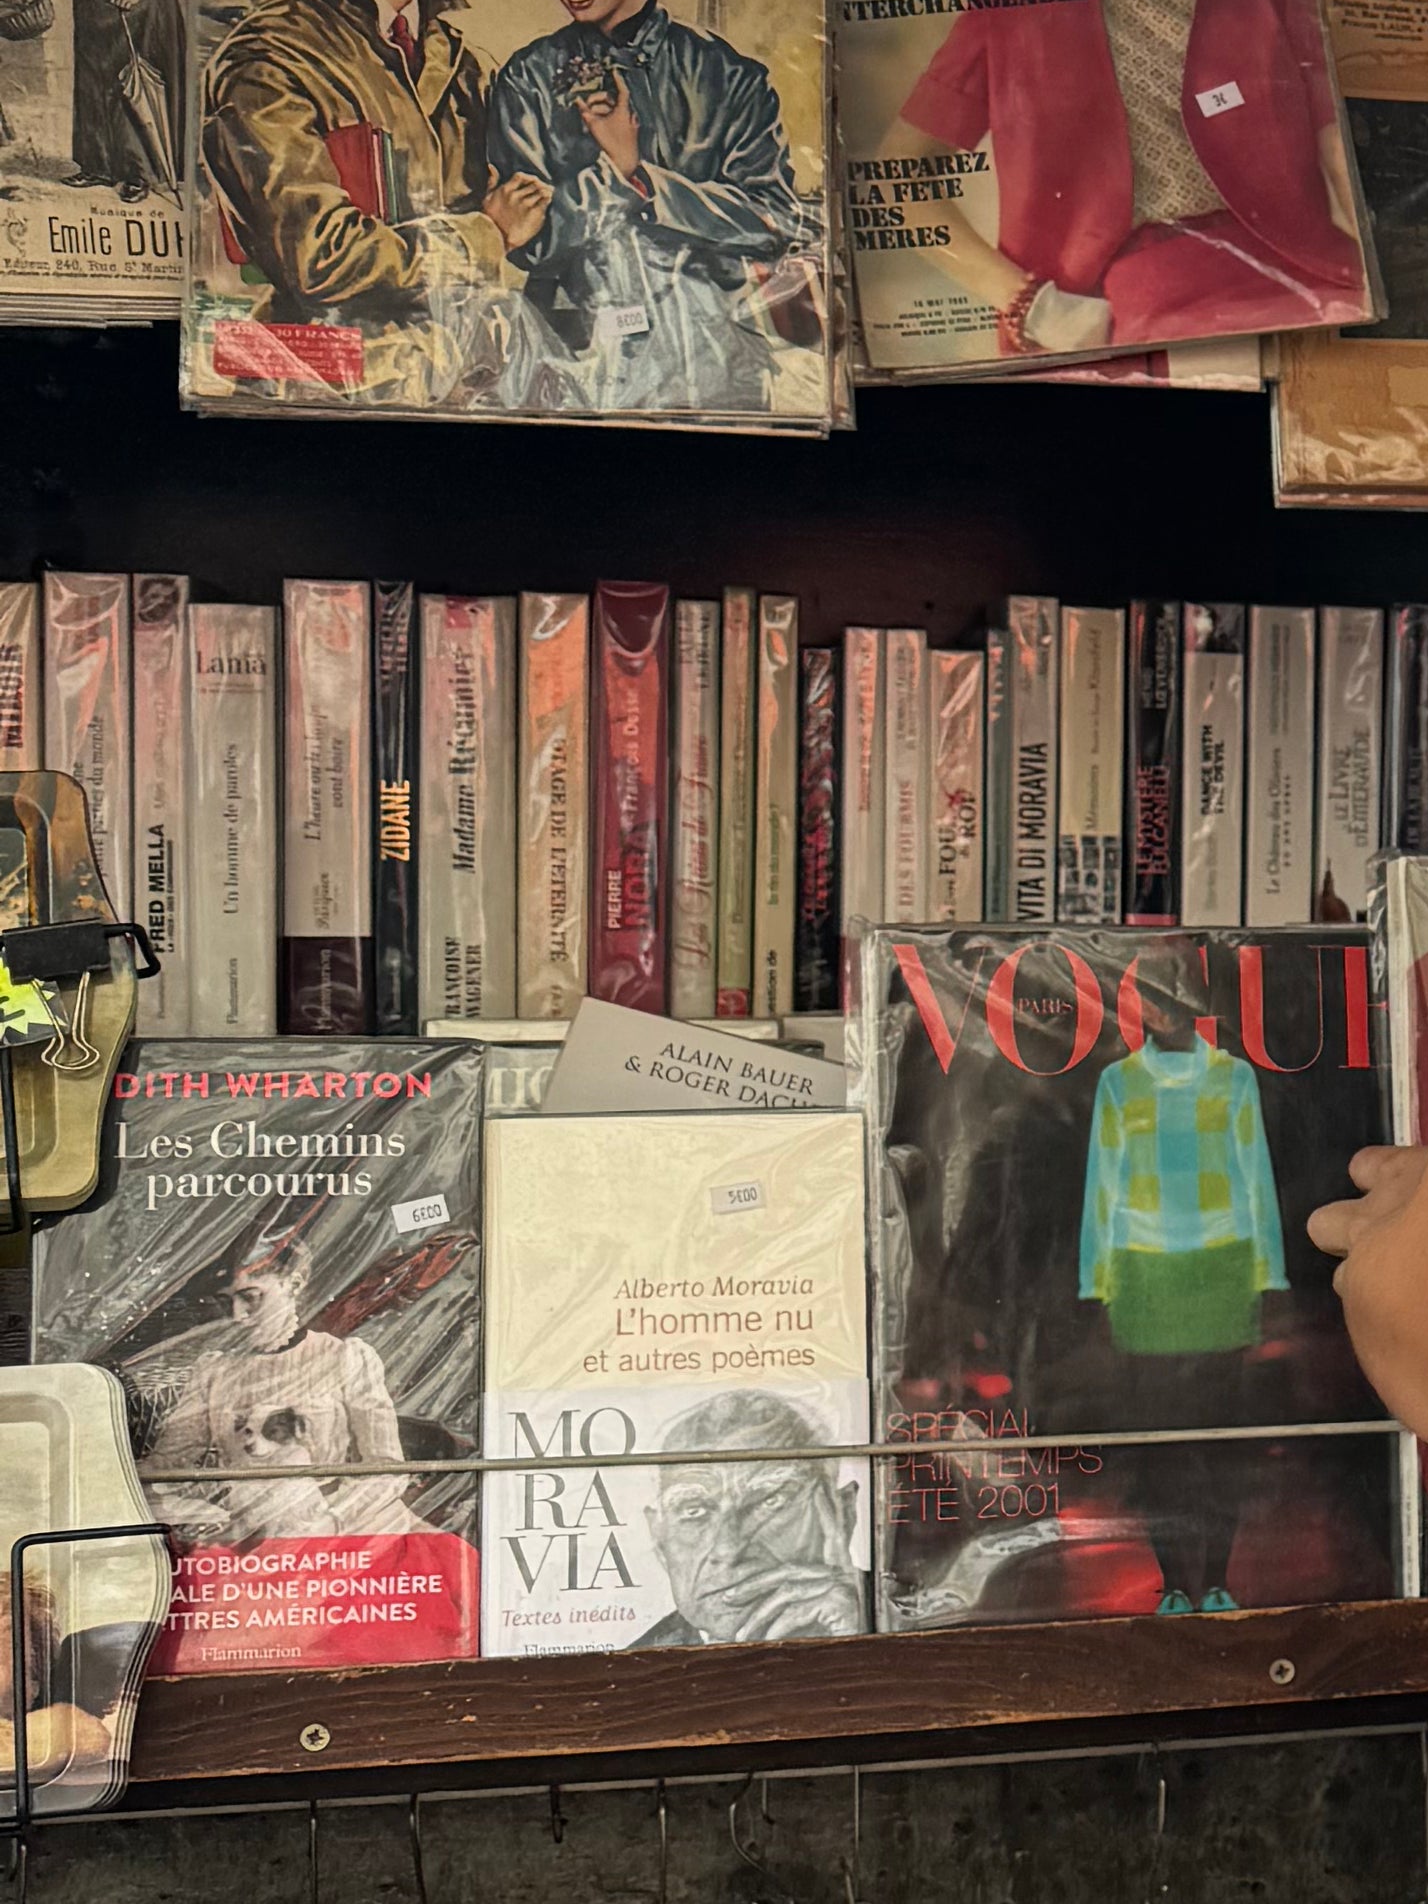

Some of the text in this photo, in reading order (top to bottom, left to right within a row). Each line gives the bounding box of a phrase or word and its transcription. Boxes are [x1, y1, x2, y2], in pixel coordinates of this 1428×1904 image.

[848, 151, 991, 182] PREPAREZ
[849, 177, 964, 206] LA FETE
[48, 216, 112, 255] Emile
[851, 206, 906, 229] DES
[854, 225, 951, 251] MERES
[88, 260, 117, 272] Rue
[195, 649, 268, 678] Lama
[621, 740, 641, 811] François
[1201, 724, 1214, 816] DANCE WITH
[1213, 740, 1225, 784] DEVIL
[223, 743, 241, 915] Un homme de paroles
[381, 779, 411, 862] ZIDANE
[452, 784, 477, 875] Madame
[1017, 742, 1047, 921] VITA DI MORAVIA
[148, 823, 166, 893] MELLA
[607, 870, 621, 929] PIERRE
[148, 900, 166, 954] FRED
[1017, 997, 1073, 1015] PARIS
[225, 1071, 433, 1099] WHARTON
[624, 1055, 731, 1097] & ROGER
[659, 1042, 814, 1096] ALAIN BAUER
[114, 1120, 406, 1159] Les Chemins
[145, 1169, 373, 1211] parcourus
[613, 1275, 815, 1300] Alberto Moravia
[615, 1305, 814, 1336] L'homme nu
[582, 1343, 816, 1374] et autres poèmes
[507, 1407, 636, 1458] MO
[515, 1469, 629, 1531] RA
[888, 1480, 1060, 1524] ÉTÉ 2001
[500, 1530, 643, 1594] VIA
[222, 1579, 300, 1603] D'UNE
[305, 1569, 444, 1599] PIONNIÈRE
[245, 1601, 419, 1628] AMÉRICAINES
[501, 1604, 637, 1627] Textes inédits
[201, 1643, 302, 1662] Flammarion
